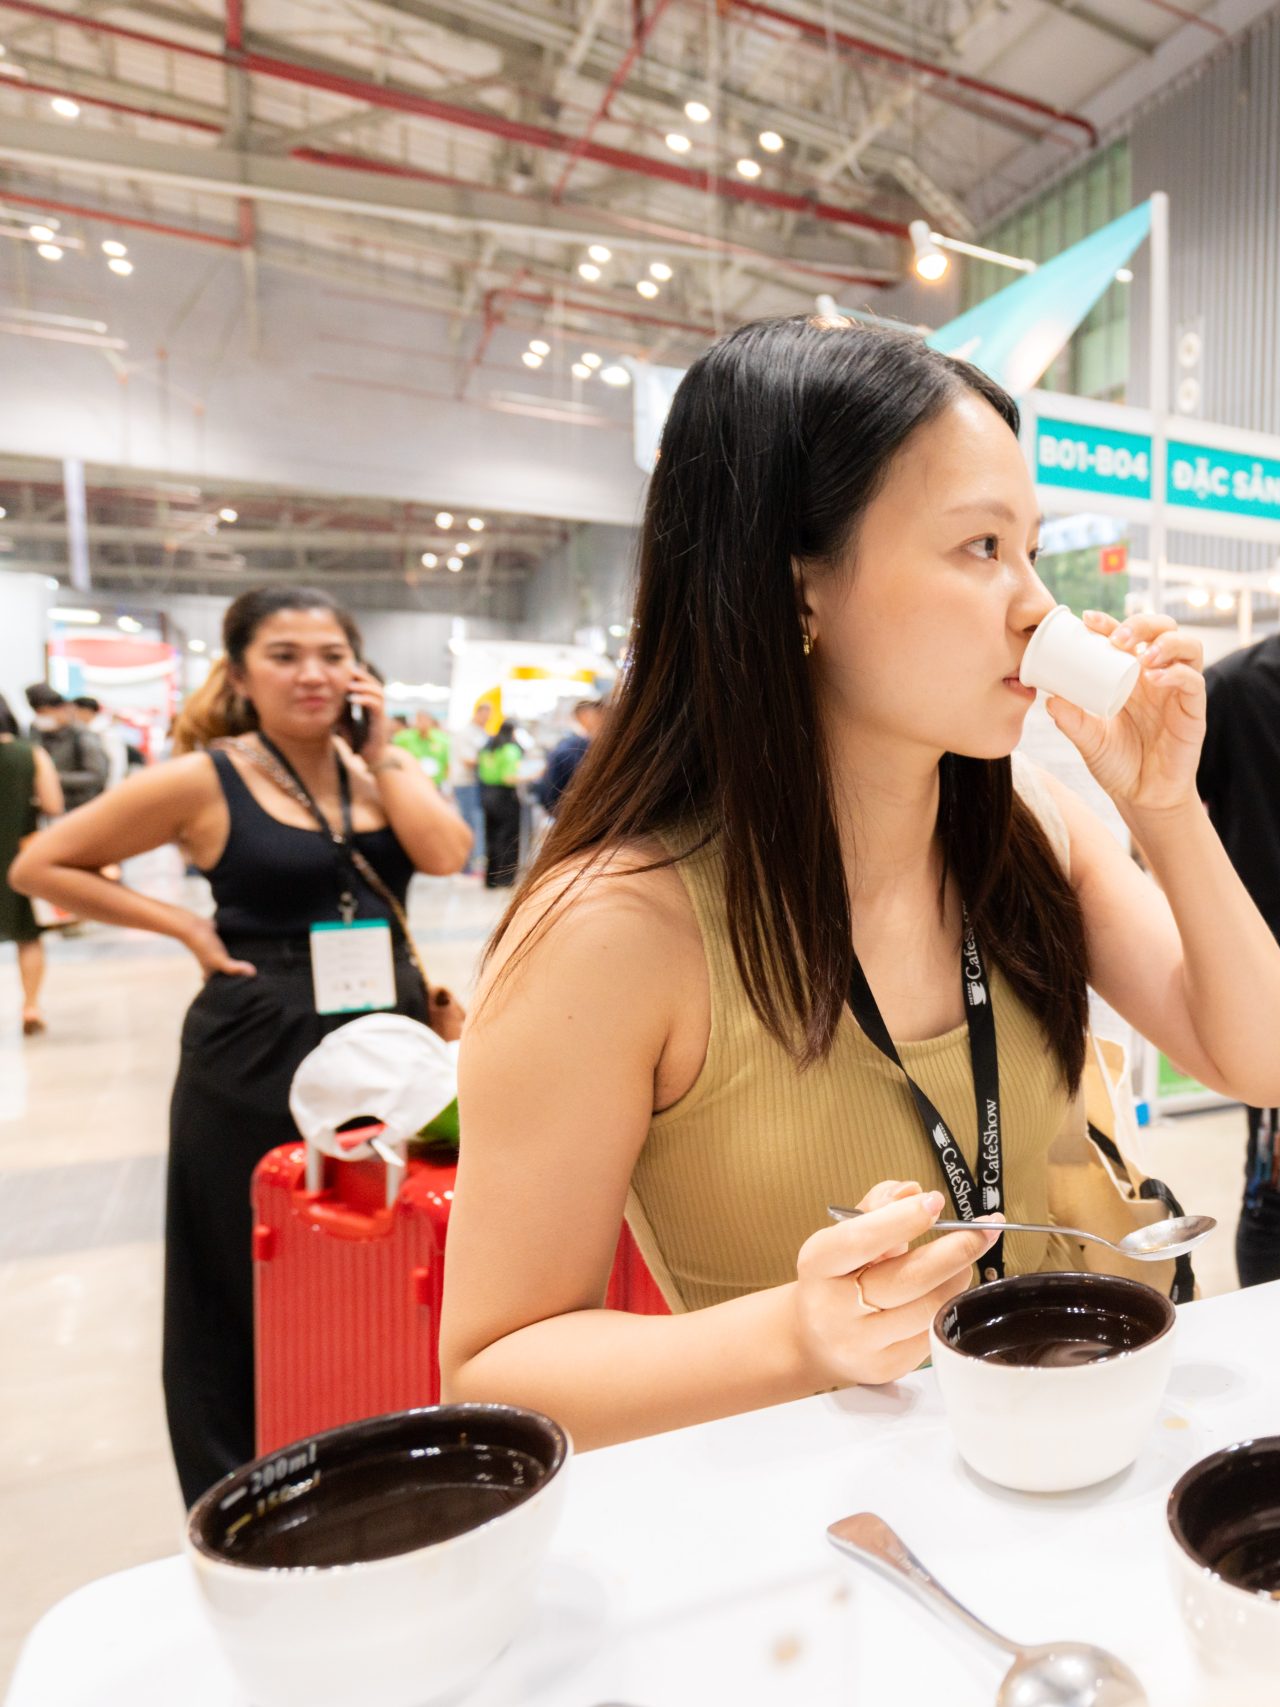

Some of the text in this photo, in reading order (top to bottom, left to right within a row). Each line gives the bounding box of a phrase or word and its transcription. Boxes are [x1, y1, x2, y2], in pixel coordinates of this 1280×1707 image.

[1038, 434, 1150, 482] B01-B04
[983, 1099, 1000, 1185] CafeShow
[942, 1147, 976, 1221] CafeShow
[250, 1442, 317, 1496] 200ml
